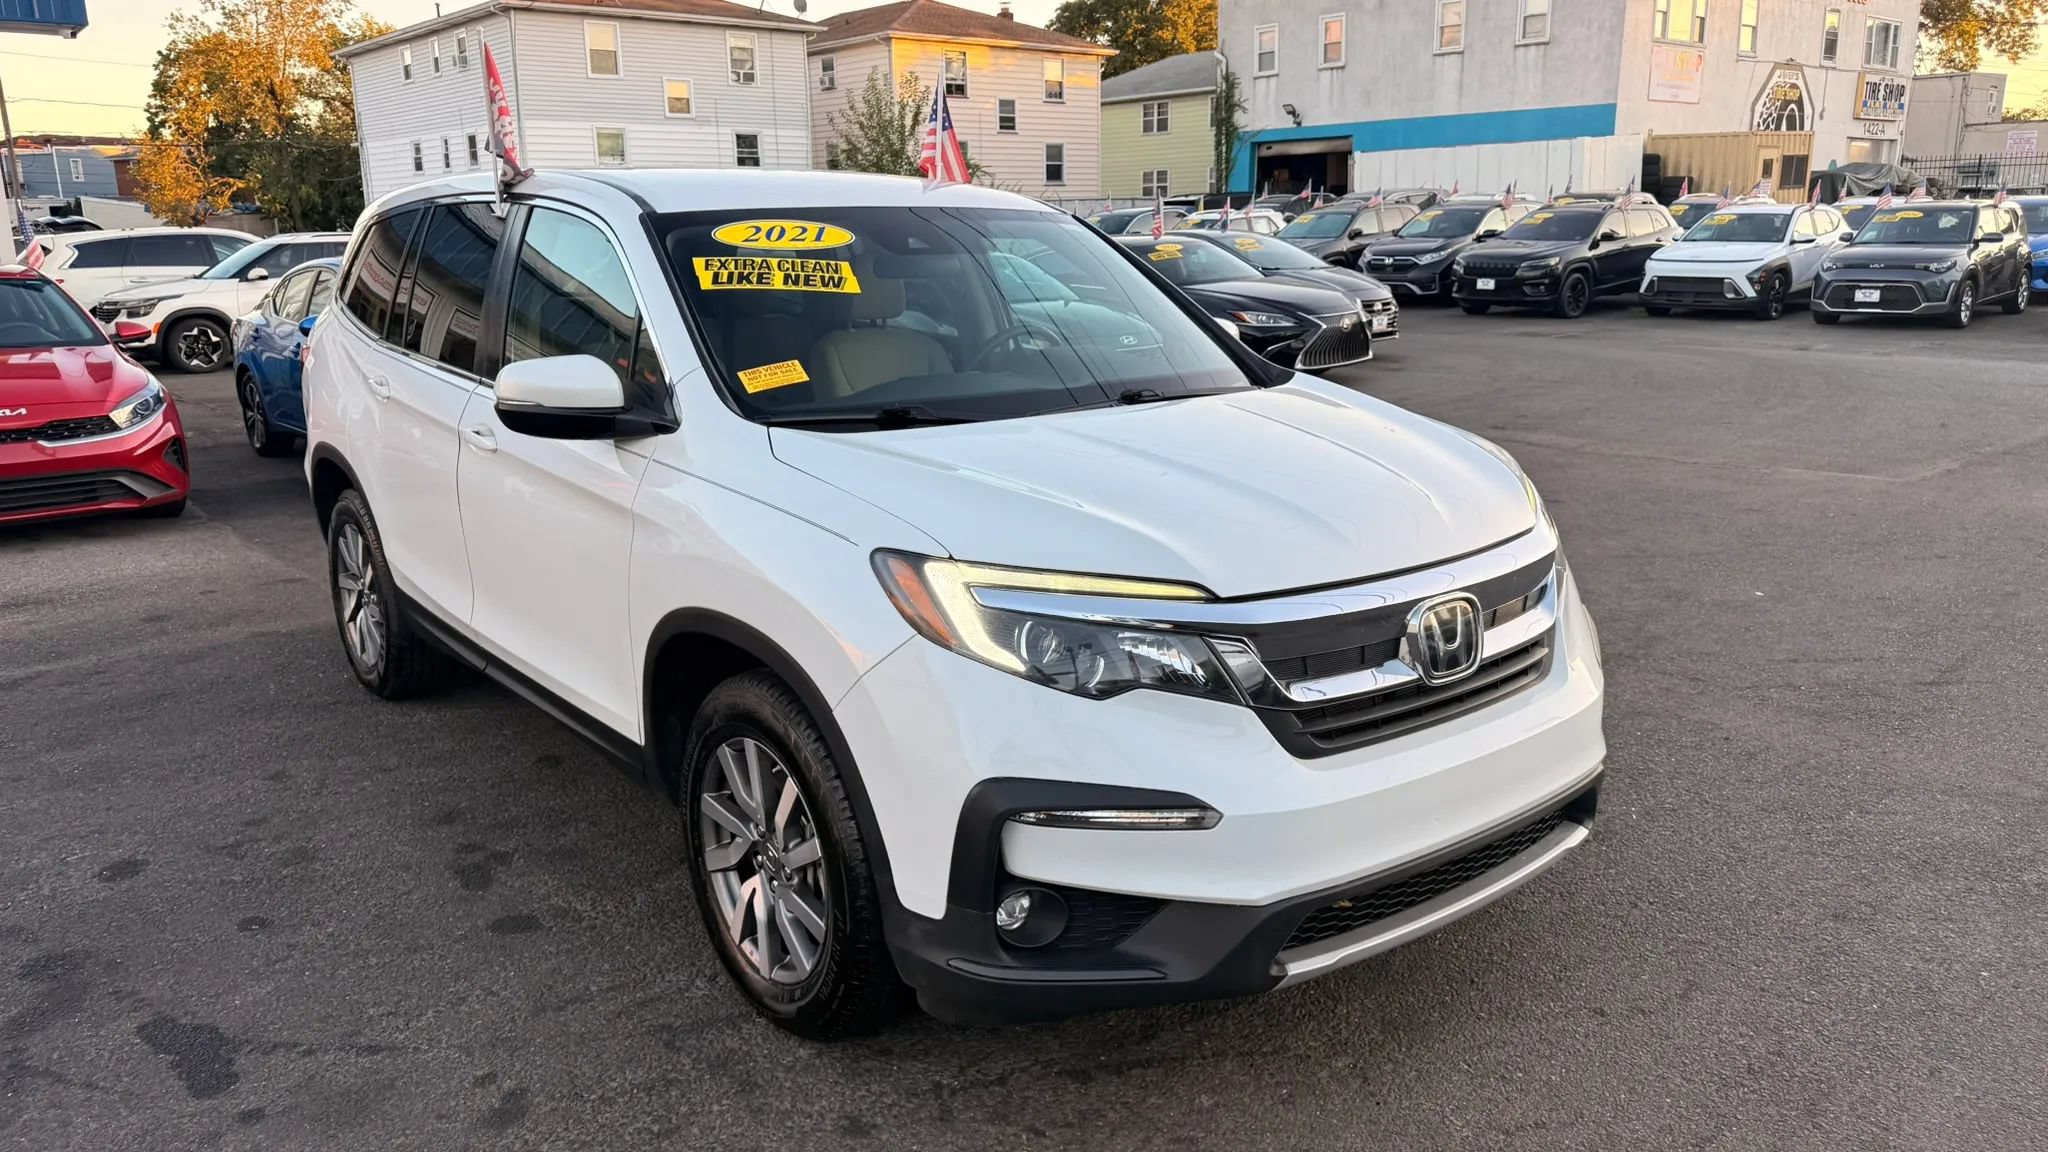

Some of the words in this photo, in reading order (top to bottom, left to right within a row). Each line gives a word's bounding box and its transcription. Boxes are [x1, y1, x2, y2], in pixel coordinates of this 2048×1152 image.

[1864, 81, 1881, 101] TIRE
[1883, 83, 1905, 102] SHOP
[742, 225, 827, 243] 2021
[704, 258, 774, 272] EXTRA
[777, 259, 843, 275] CLEAN
[711, 271, 775, 287] LIKE
[782, 273, 847, 289] NEW
[743, 368, 763, 377] THIS
[762, 361, 798, 372] VEHICLE
[747, 374, 762, 382] NOT
[780, 367, 798, 375] SALE
